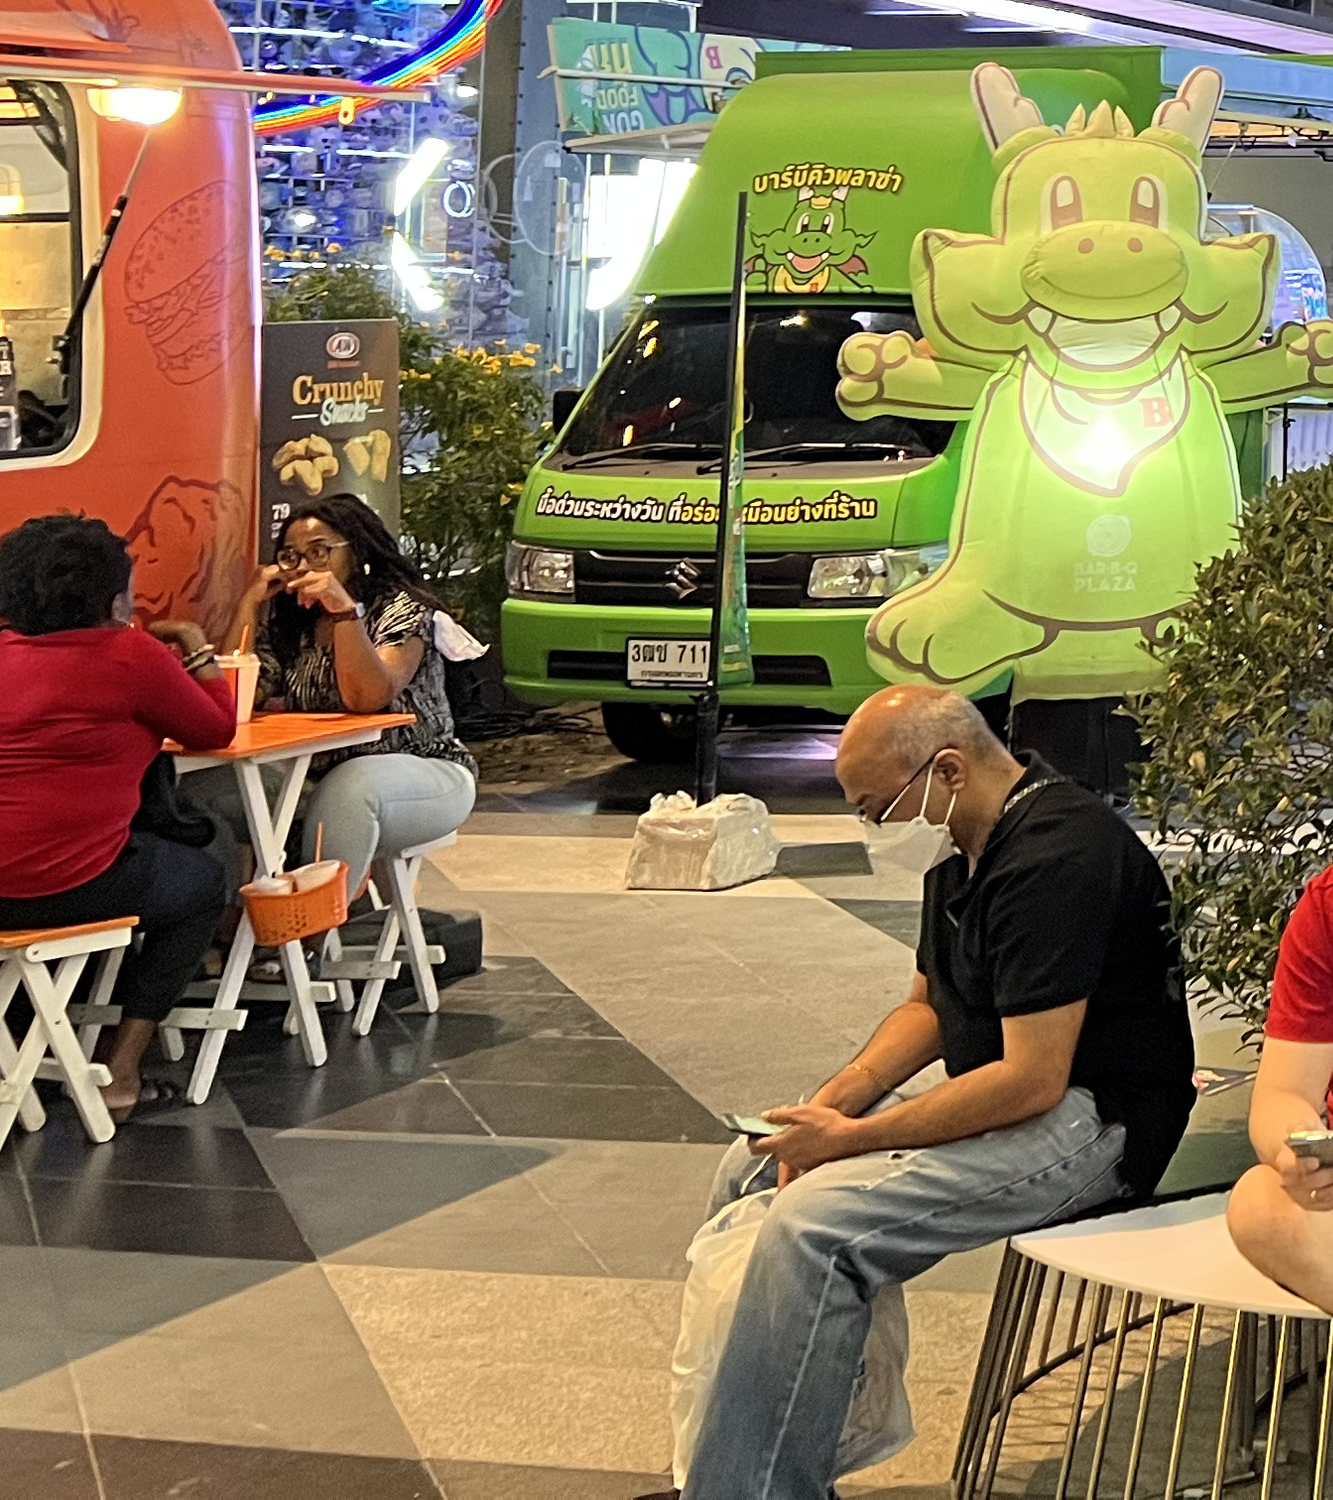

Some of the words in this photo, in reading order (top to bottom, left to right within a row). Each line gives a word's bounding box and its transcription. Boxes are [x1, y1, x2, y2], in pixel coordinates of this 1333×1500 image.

[754, 162, 903, 193] บาร์บีคิวพลาซ่า
[293, 372, 384, 405] Crunchy
